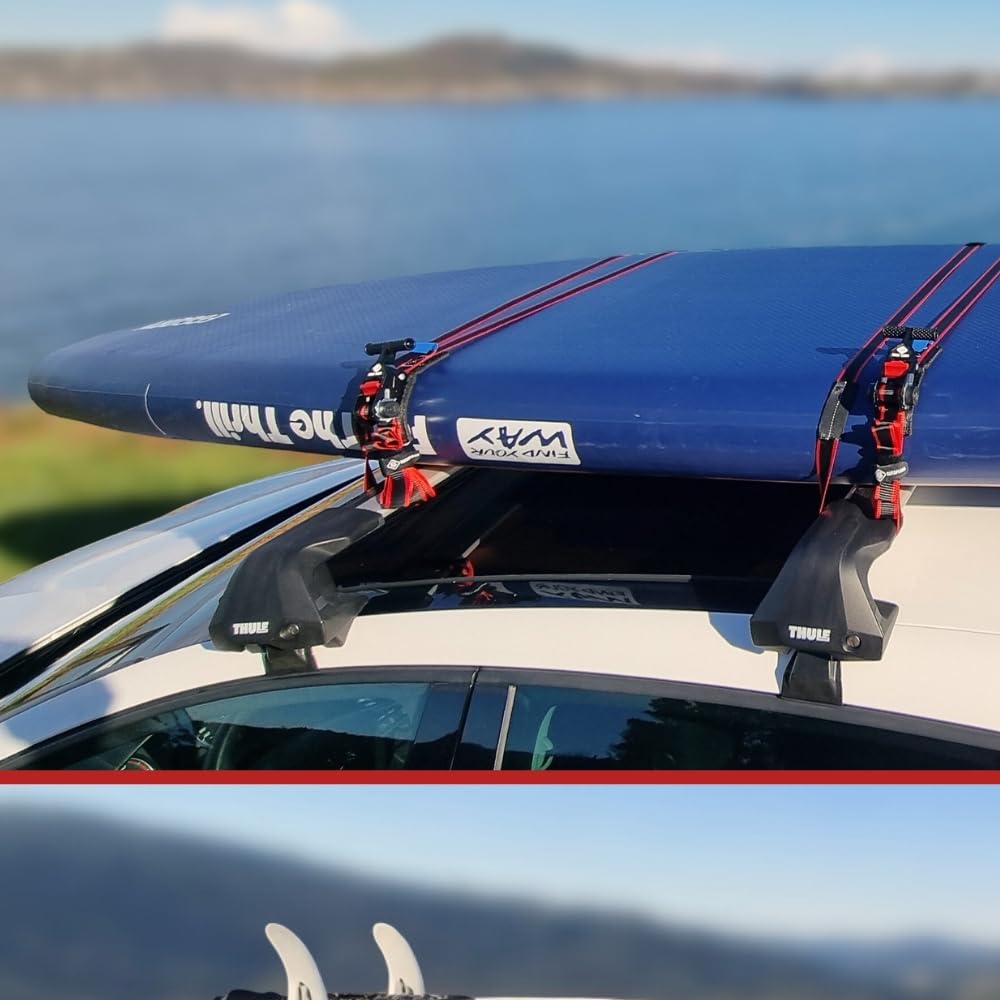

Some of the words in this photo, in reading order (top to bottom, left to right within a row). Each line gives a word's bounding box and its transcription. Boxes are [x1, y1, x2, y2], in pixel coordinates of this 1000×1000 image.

[467, 425, 568, 450] WAY
[470, 447, 519, 458] YOUR
[522, 448, 571, 459] FIND
[232, 620, 270, 635] THULE
[788, 625, 832, 643] THULE
